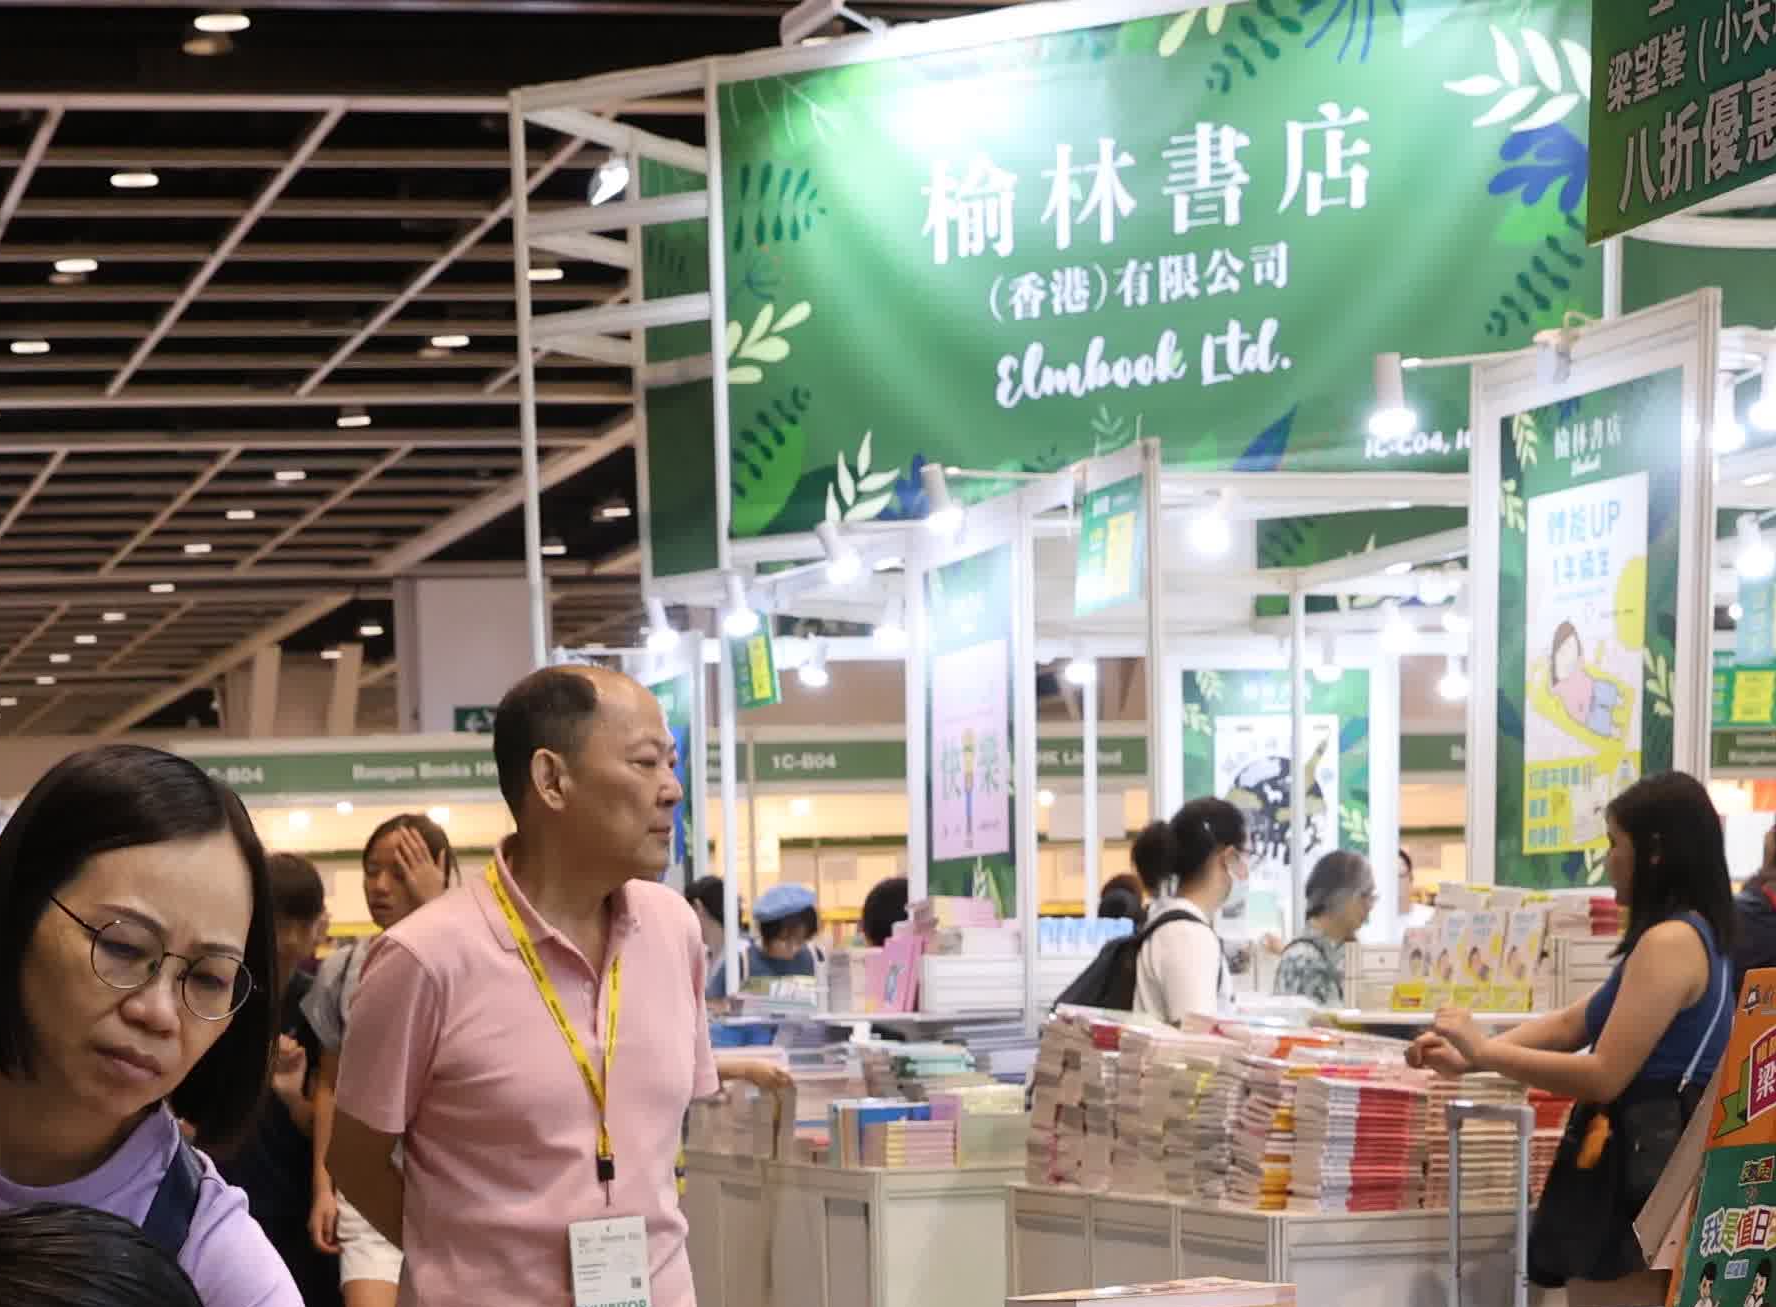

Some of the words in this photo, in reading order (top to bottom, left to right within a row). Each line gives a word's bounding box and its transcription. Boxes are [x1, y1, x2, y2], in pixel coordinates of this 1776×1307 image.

[920, 100, 1372, 267] 榆林書店
[989, 240, 1290, 325] （香港）有限公司
[995, 330, 1186, 409] Elmbook
[1200, 318, 1293, 386] Ltd.
